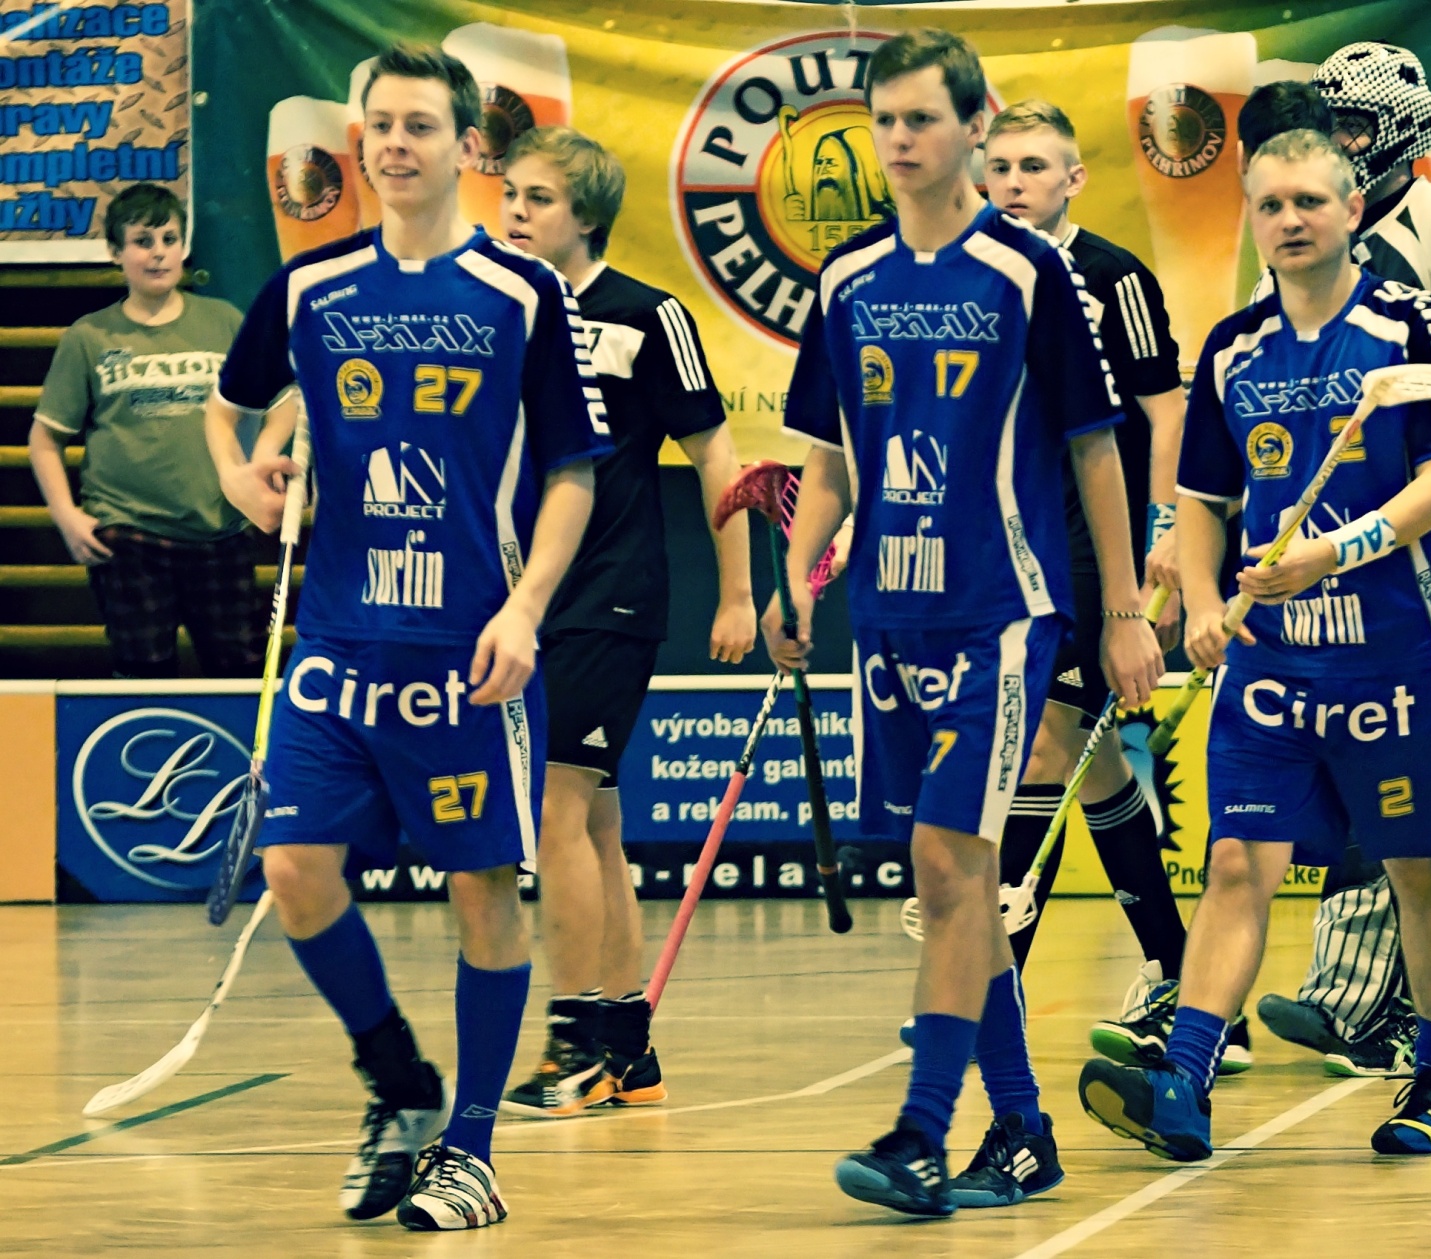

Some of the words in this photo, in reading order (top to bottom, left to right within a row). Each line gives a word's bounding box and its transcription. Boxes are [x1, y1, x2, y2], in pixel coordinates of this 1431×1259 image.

[0, 101, 114, 139] ravy
[0, 140, 186, 188] mpletní
[413, 364, 482, 415] 27
[933, 349, 979, 399] 17
[1328, 415, 1366, 464] 2
[363, 502, 445, 518] PROJECT
[882, 489, 945, 505] PROJECT
[288, 656, 466, 727] Ciret
[1243, 679, 1415, 742] Ciret
[651, 712, 749, 743] výroba
[428, 770, 489, 824] 27
[651, 801, 670, 822] a
[797, 801, 859, 826] ped
[1223, 804, 1276, 815] SALMING
[1378, 775, 1415, 818] 2
